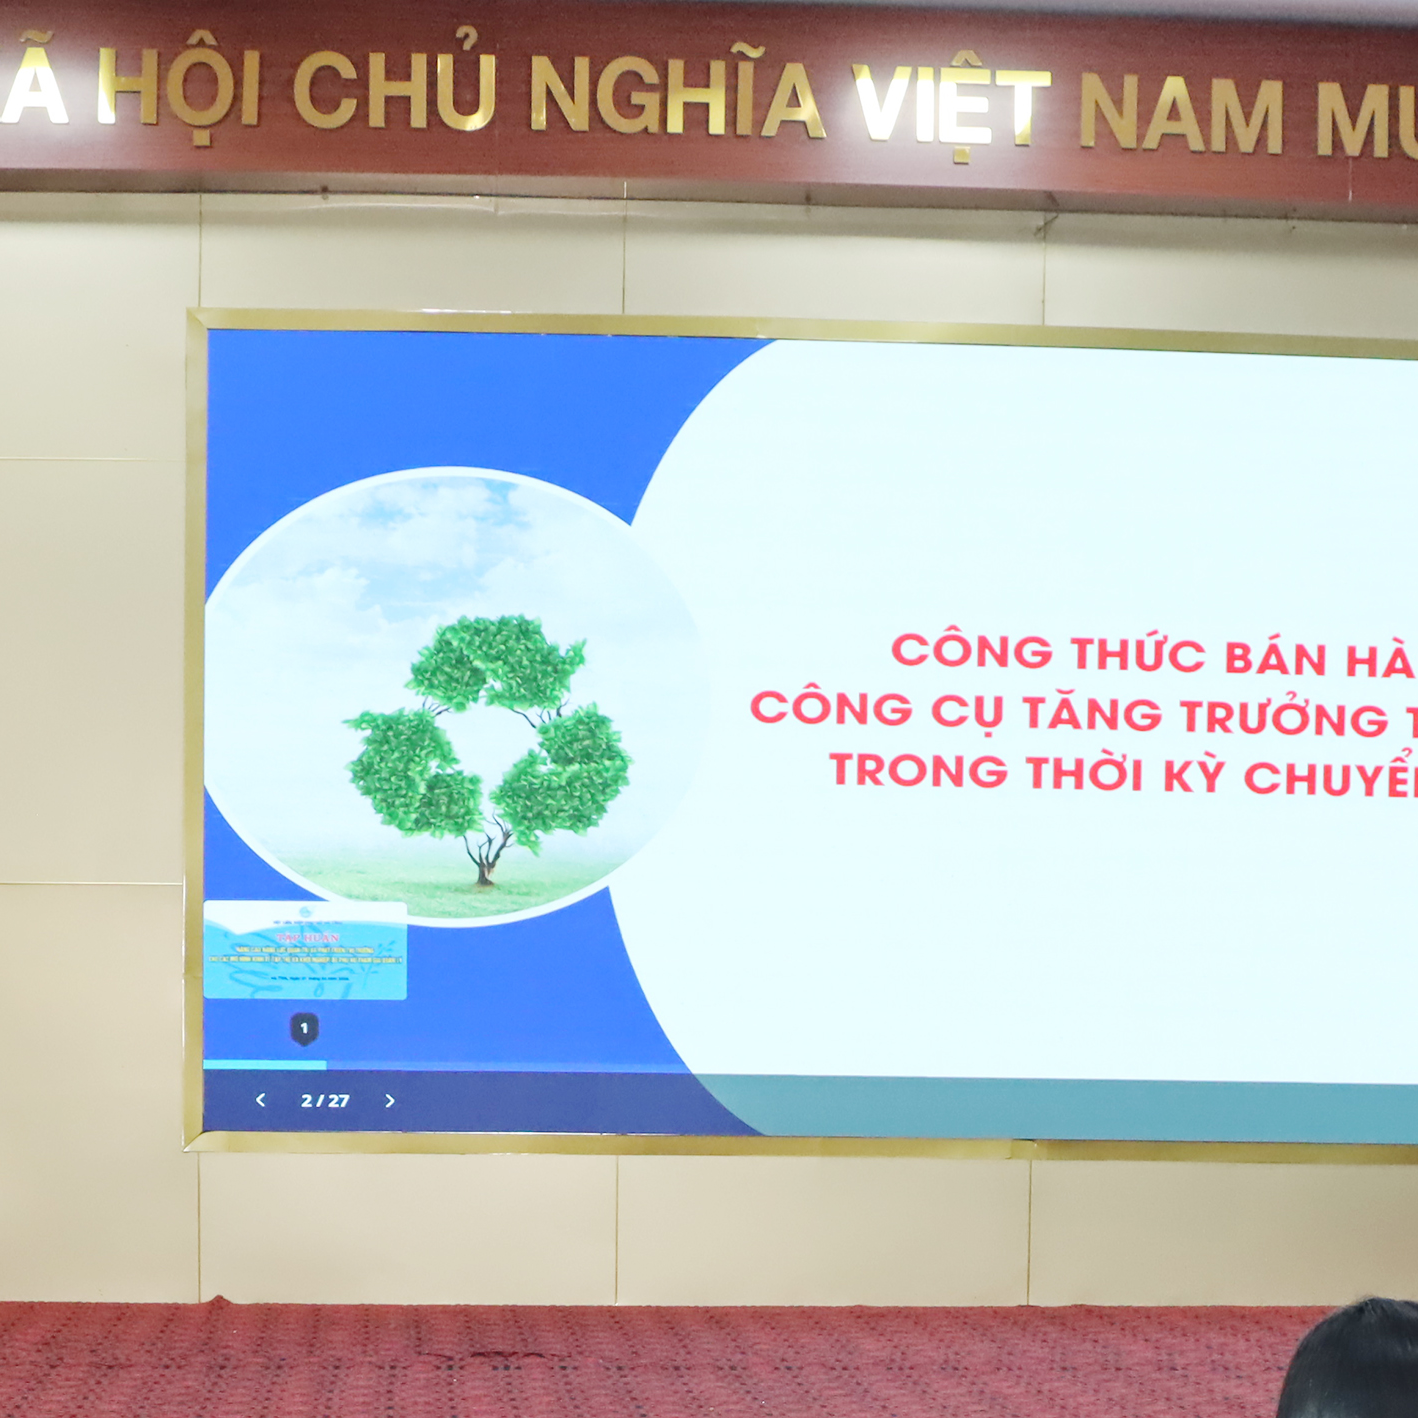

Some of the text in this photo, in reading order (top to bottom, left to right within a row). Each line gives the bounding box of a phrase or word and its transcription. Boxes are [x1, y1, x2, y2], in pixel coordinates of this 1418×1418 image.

[97, 29, 260, 147] HỘI
[293, 25, 496, 131] CHỦ
[531, 41, 826, 138] NGHĨA
[852, 50, 1052, 164] VIỆT
[1080, 72, 1283, 154] NAM
[891, 624, 1053, 670] CÔNG
[1070, 629, 1206, 674] THỨC
[1225, 633, 1326, 677] BÁN
[750, 682, 913, 727] CÔNG
[931, 694, 1003, 738] CỤ
[1021, 688, 1162, 733] TĂNG
[1181, 690, 1389, 739] TRƯỞNG
[828, 752, 1008, 789] TRONG
[1026, 748, 1143, 793] THỜI
[1163, 751, 1226, 793] KỲ
[300, 1022, 309, 1034] 1
[301, 1094, 313, 1108] 2
[328, 1094, 350, 1108] 27
